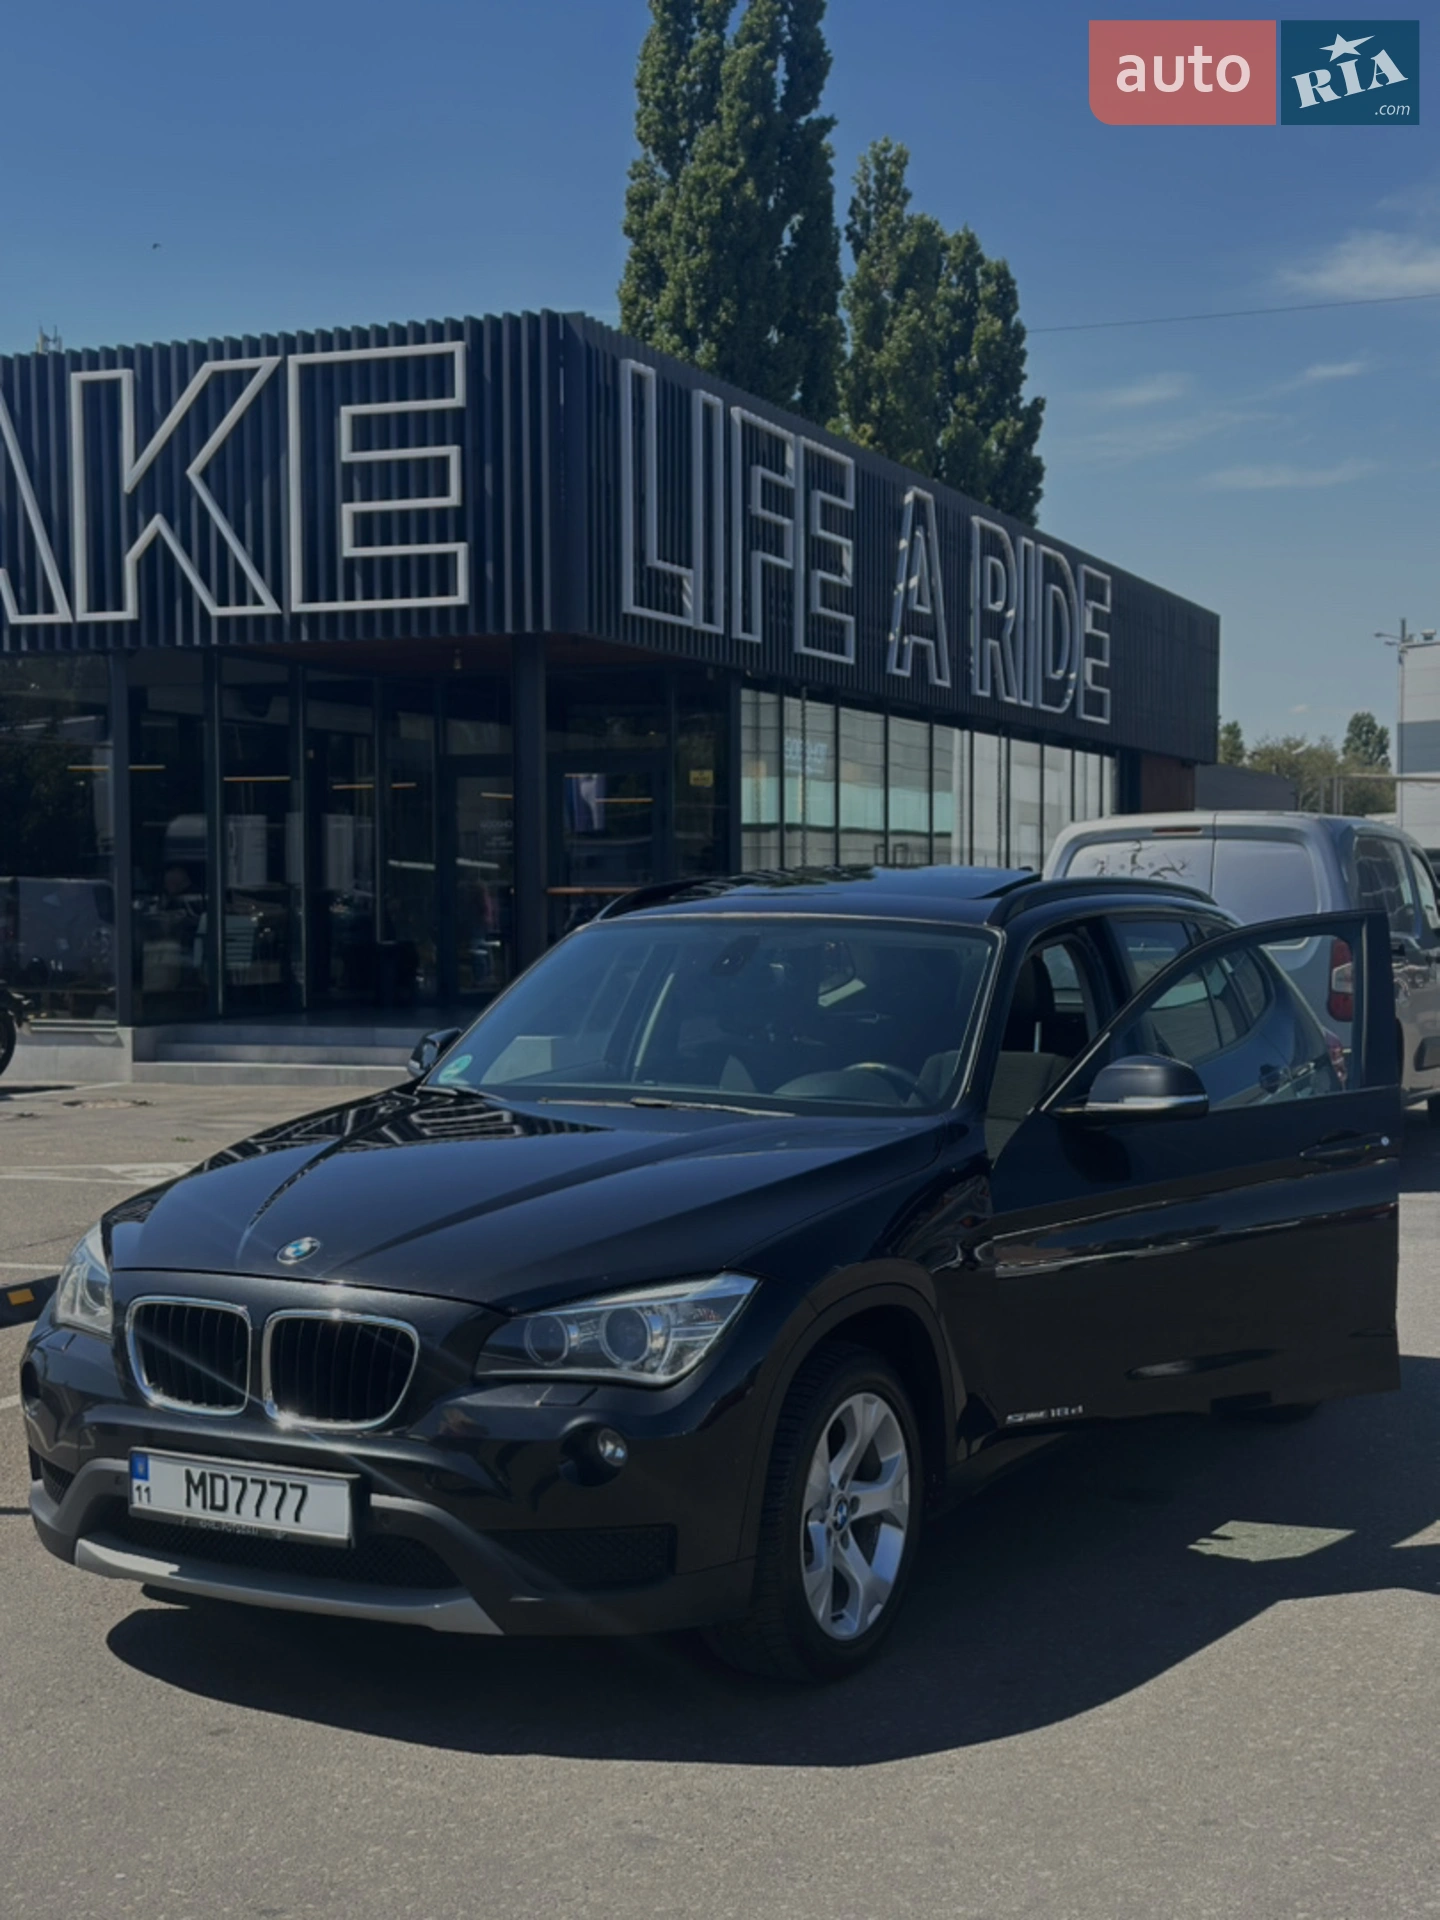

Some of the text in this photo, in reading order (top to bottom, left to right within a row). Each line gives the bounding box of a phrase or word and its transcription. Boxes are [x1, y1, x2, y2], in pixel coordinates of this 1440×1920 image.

[620, 358, 1112, 725] LIFE A RIDE
[134, 1468, 308, 1523] 11 MD7777
